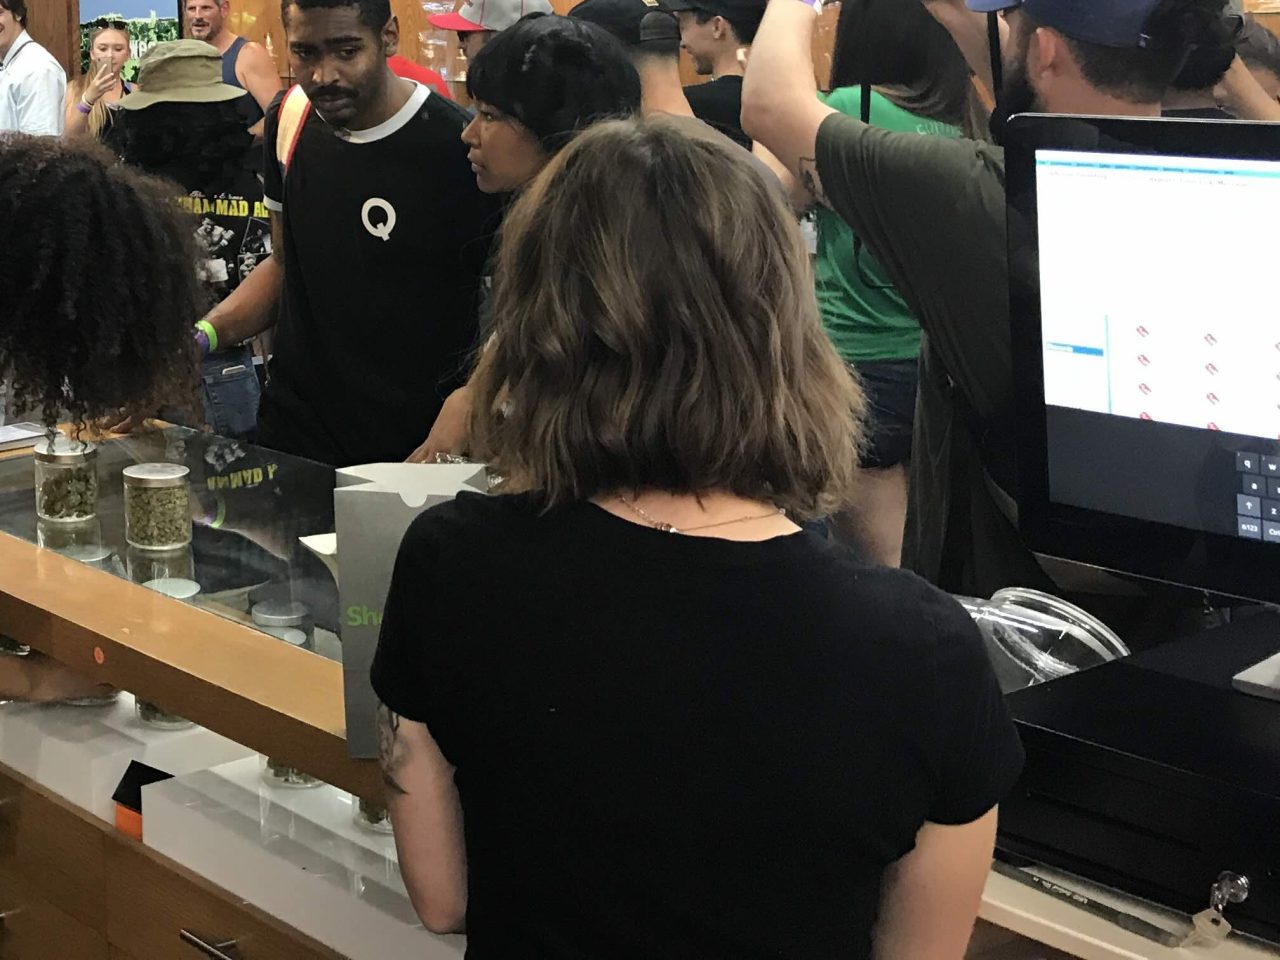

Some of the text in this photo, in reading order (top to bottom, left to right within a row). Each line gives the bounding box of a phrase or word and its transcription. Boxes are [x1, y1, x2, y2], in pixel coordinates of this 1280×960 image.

[361, 197, 396, 241] Q
[1244, 460, 1277, 471] q w
[1271, 507, 1277, 515] z
